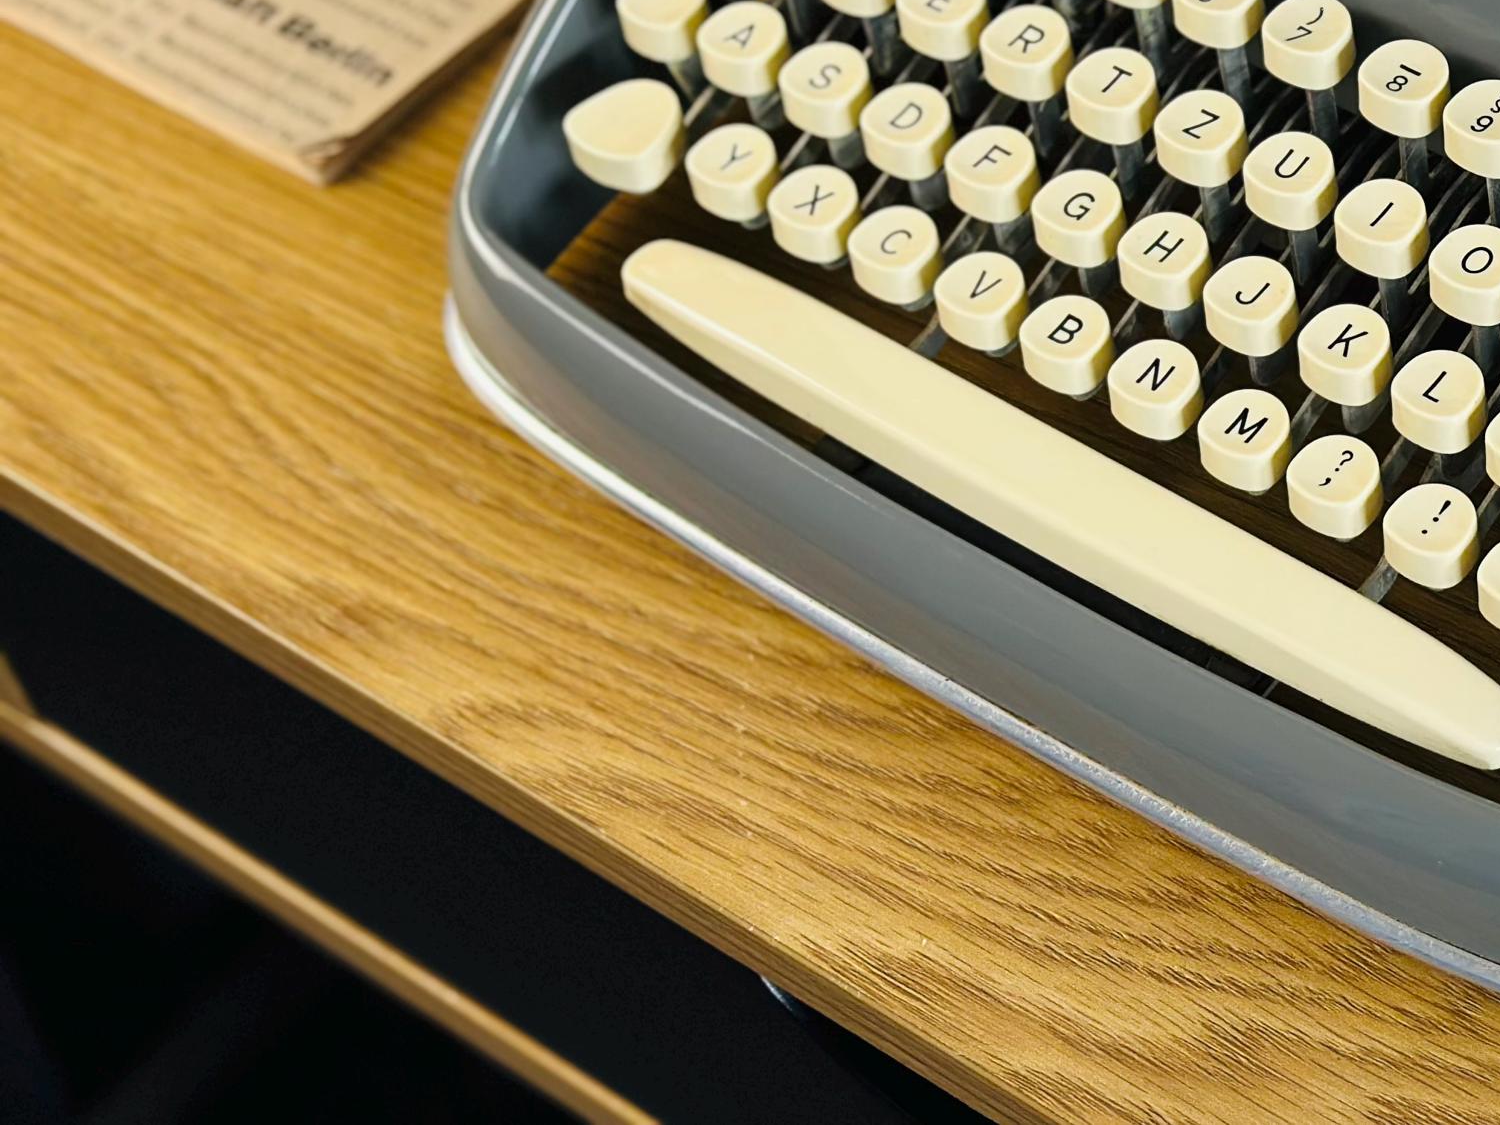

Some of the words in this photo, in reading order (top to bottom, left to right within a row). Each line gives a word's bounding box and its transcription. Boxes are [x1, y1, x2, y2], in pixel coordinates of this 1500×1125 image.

[719, 145, 752, 170] Y
[796, 186, 832, 215] X
[881, 230, 912, 254] C
[970, 271, 1001, 298] V
[1048, 314, 1083, 344] B
[1136, 358, 1175, 391] N
[1225, 408, 1268, 443] M
[724, 25, 754, 47] A
[809, 65, 841, 89] S
[890, 103, 922, 129] D
[973, 145, 1011, 167] F
[1064, 193, 1095, 220] G
[1144, 231, 1184, 262] H
[1236, 283, 1270, 304] J
[1328, 324, 1368, 357] K
[1423, 371, 1446, 402] L
[1009, 25, 1044, 53] R
[1102, 66, 1132, 92] T
[1182, 109, 1219, 139] Z
[1275, 149, 1309, 178] U
[1370, 202, 1393, 226] I
[1461, 247, 1493, 273] O
